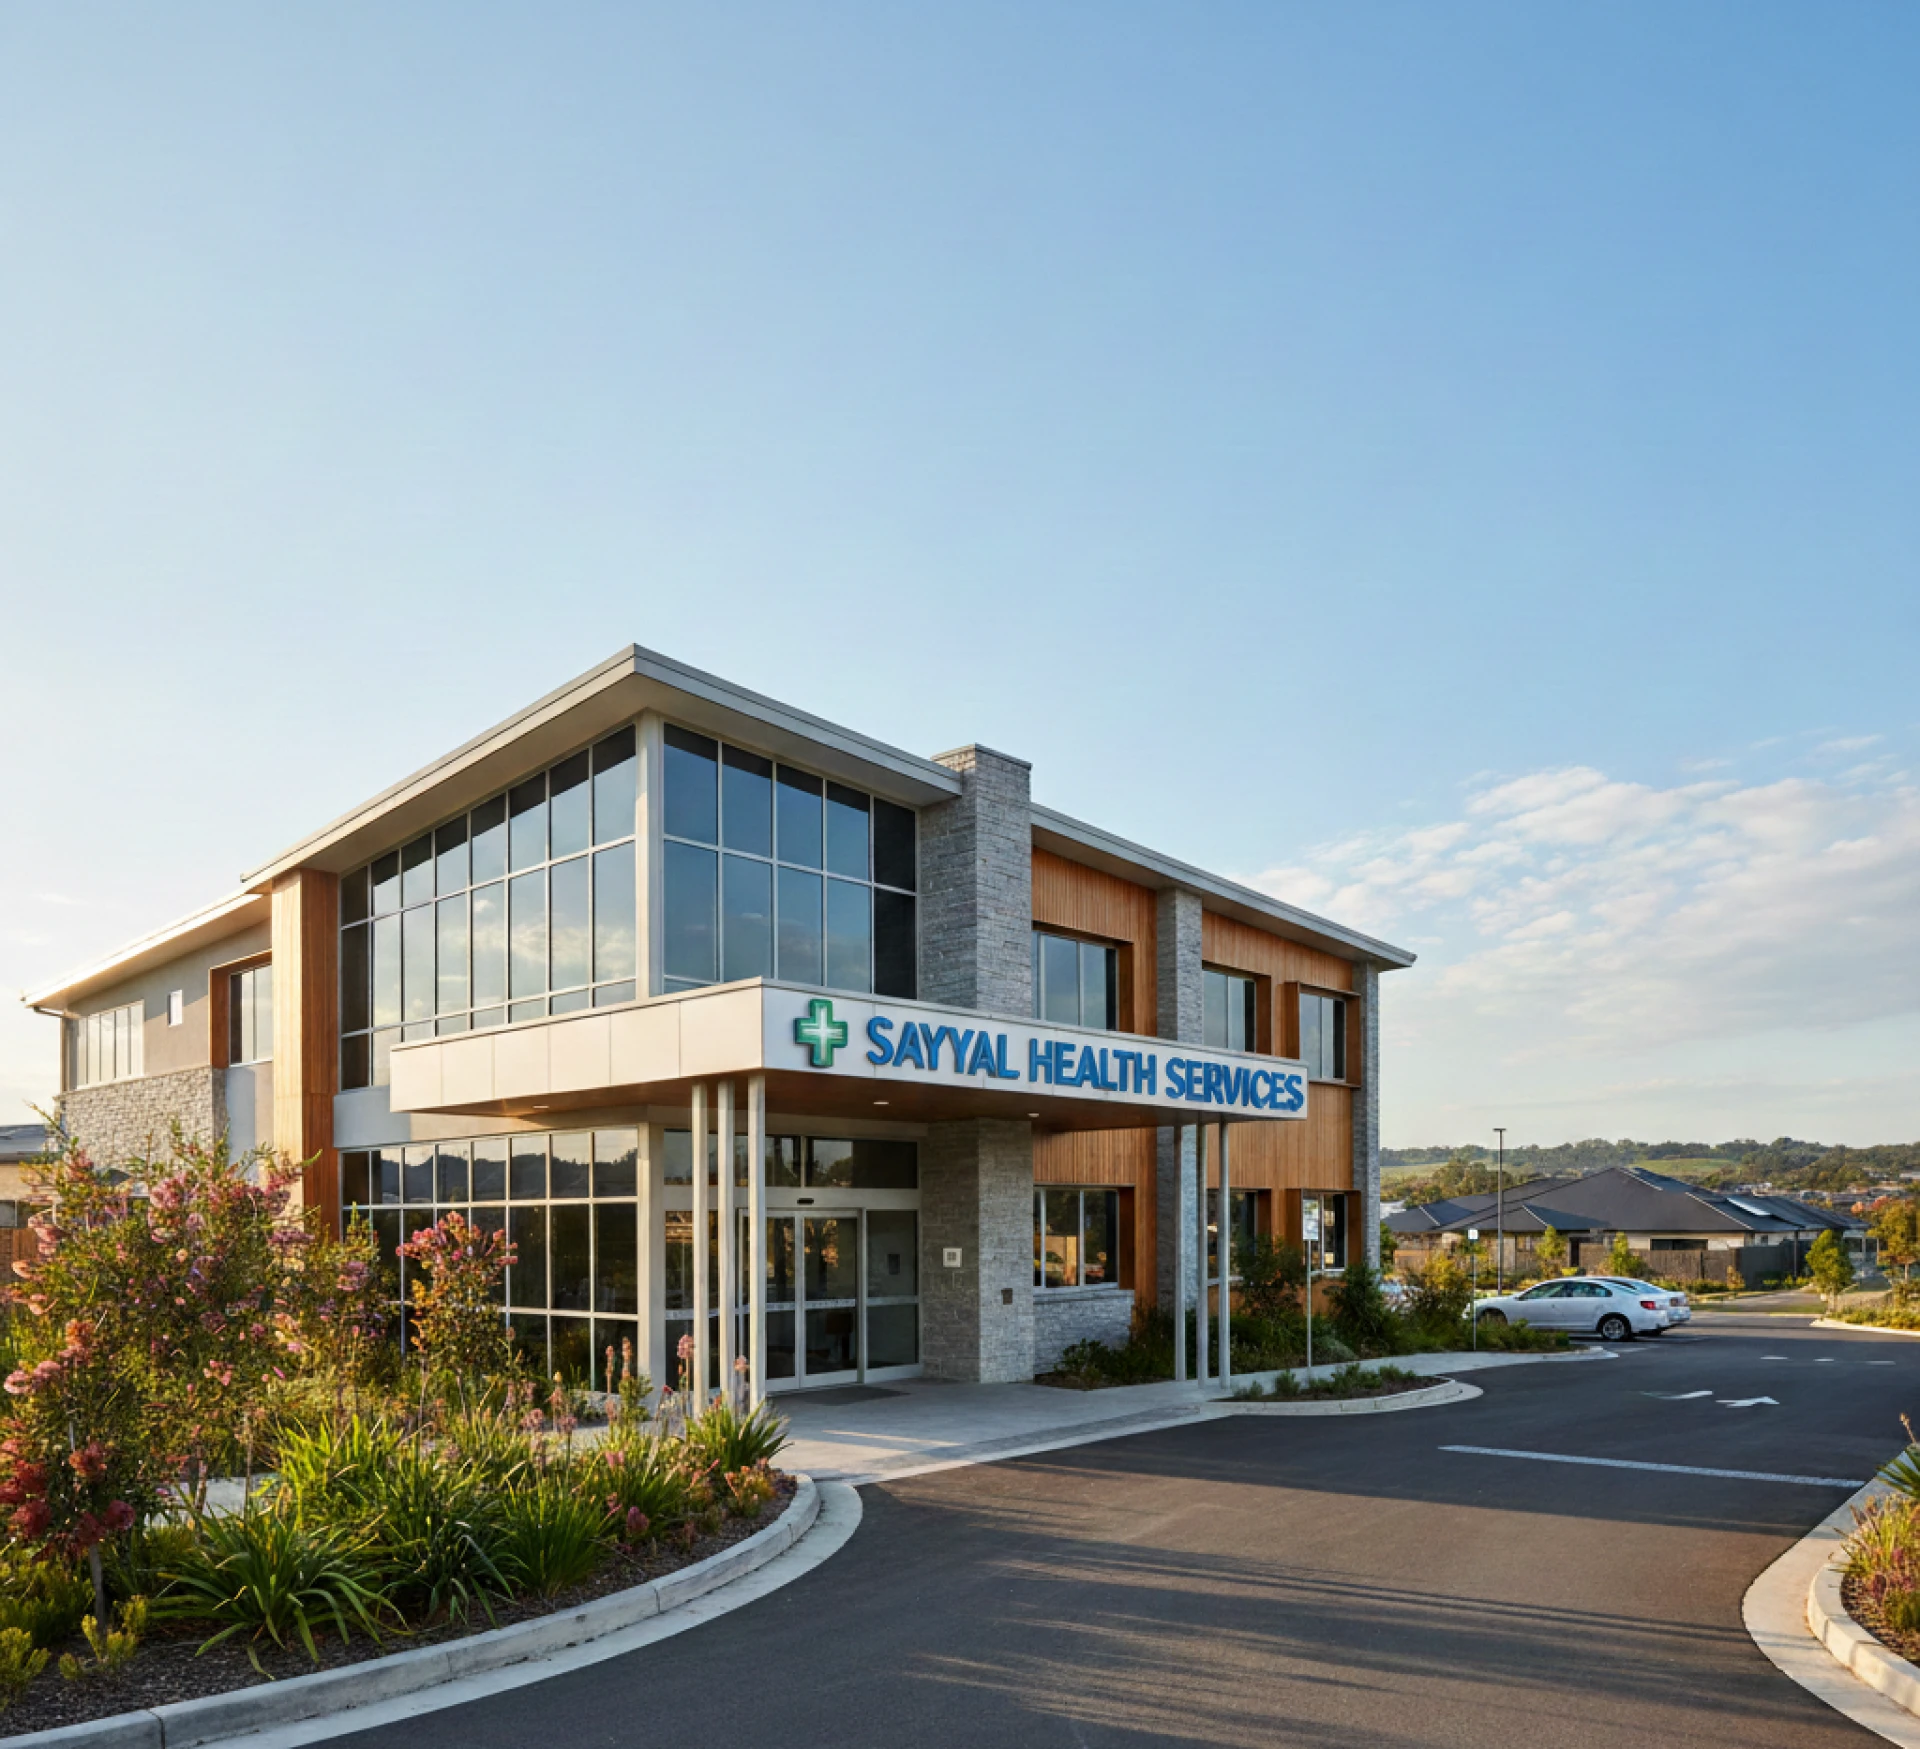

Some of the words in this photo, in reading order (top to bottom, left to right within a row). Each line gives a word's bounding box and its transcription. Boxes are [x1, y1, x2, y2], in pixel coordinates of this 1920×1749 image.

[867, 1015, 1020, 1079] SAYYAL
[1029, 1038, 1157, 1096] HEALTH
[1165, 1057, 1304, 1112] SERVICES
